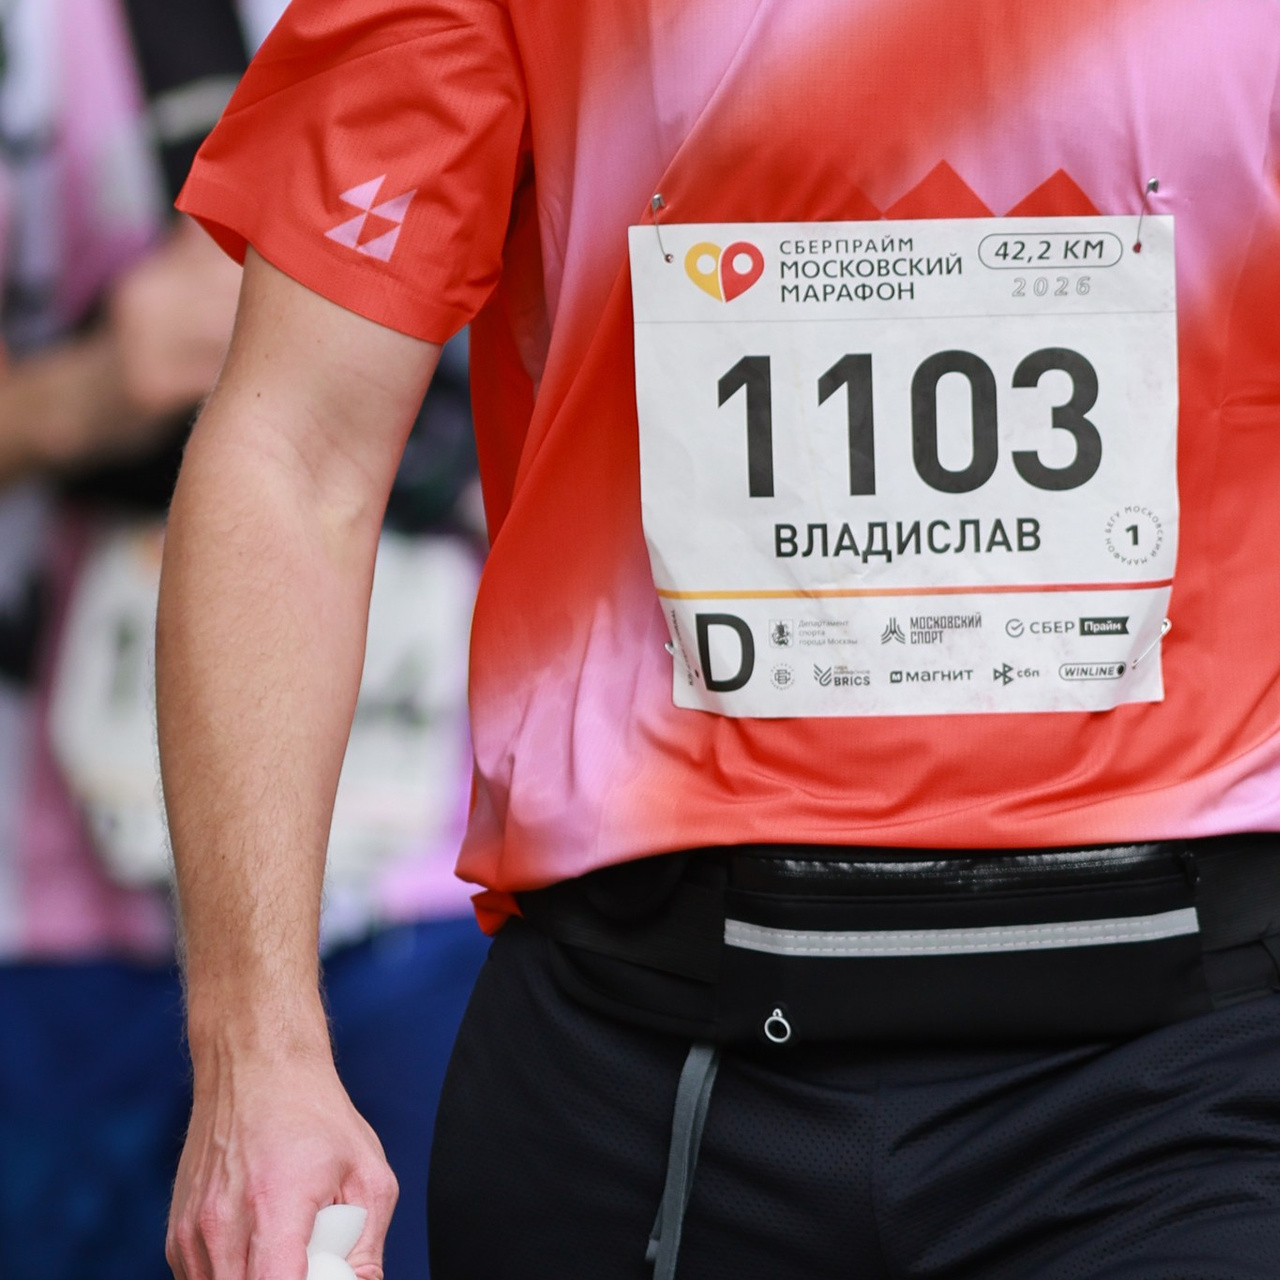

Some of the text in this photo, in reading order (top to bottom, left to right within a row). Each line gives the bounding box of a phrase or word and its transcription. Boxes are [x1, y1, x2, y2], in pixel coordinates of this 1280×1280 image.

[779, 235, 914, 255] СБЕРПРАЙМ
[995, 240, 1051, 263] 42,2
[780, 253, 962, 279] МОСКОВСКИЙ
[781, 281, 915, 303] МАРАФОН
[1012, 276, 1091, 297] 2026
[717, 347, 1103, 498] 1103
[774, 517, 1042, 563] ВЛАДИСЛАВ
[1125, 524, 1139, 546] 1
[910, 612, 982, 630] МОСКОВСКИЙ
[1029, 620, 1121, 634] СБЕР Прайм
[910, 630, 944, 645] СПОРТ
[695, 613, 755, 693] D
[834, 676, 871, 687] BRICS
[1064, 666, 1115, 677] WINLINE
